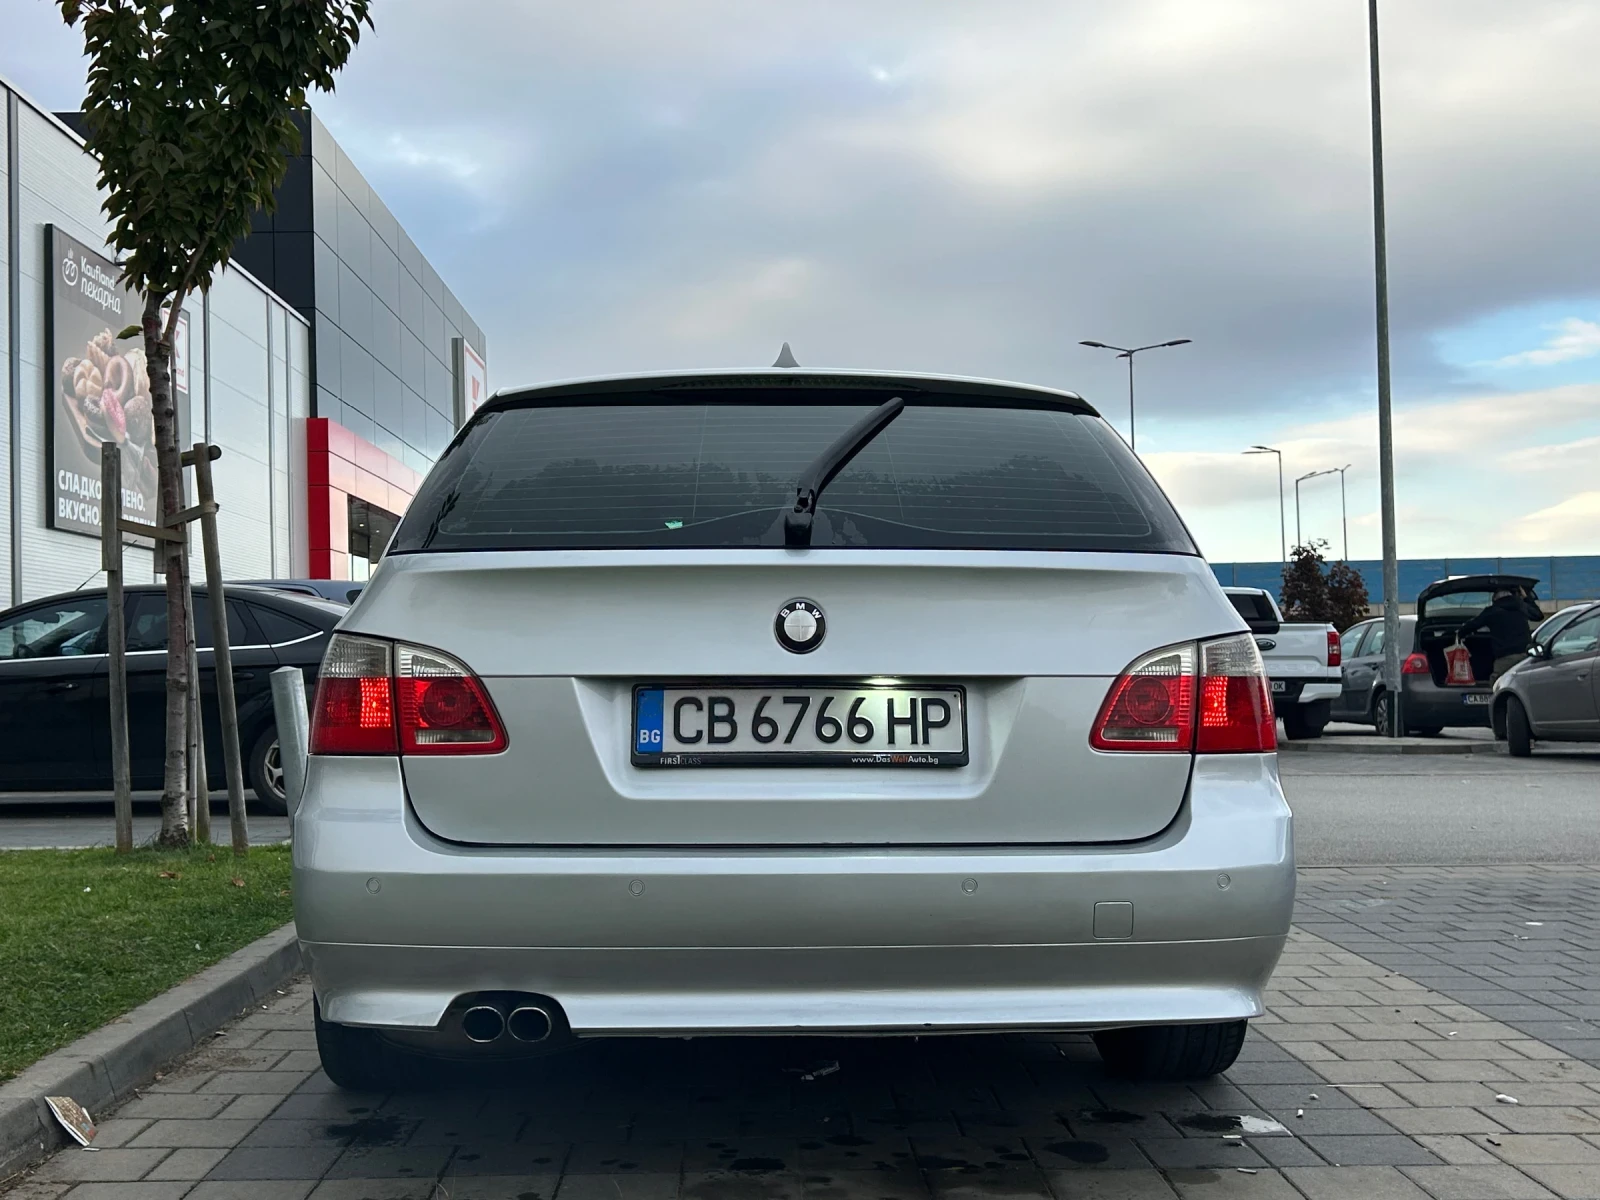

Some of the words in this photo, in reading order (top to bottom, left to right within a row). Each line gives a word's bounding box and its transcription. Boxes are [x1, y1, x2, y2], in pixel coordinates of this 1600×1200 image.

[81, 255, 115, 291] Kaufland
[780, 602, 822, 619] BMW
[639, 729, 661, 744] BG
[673, 696, 738, 744] CB
[751, 696, 874, 744] 6766
[887, 697, 951, 745] HP
